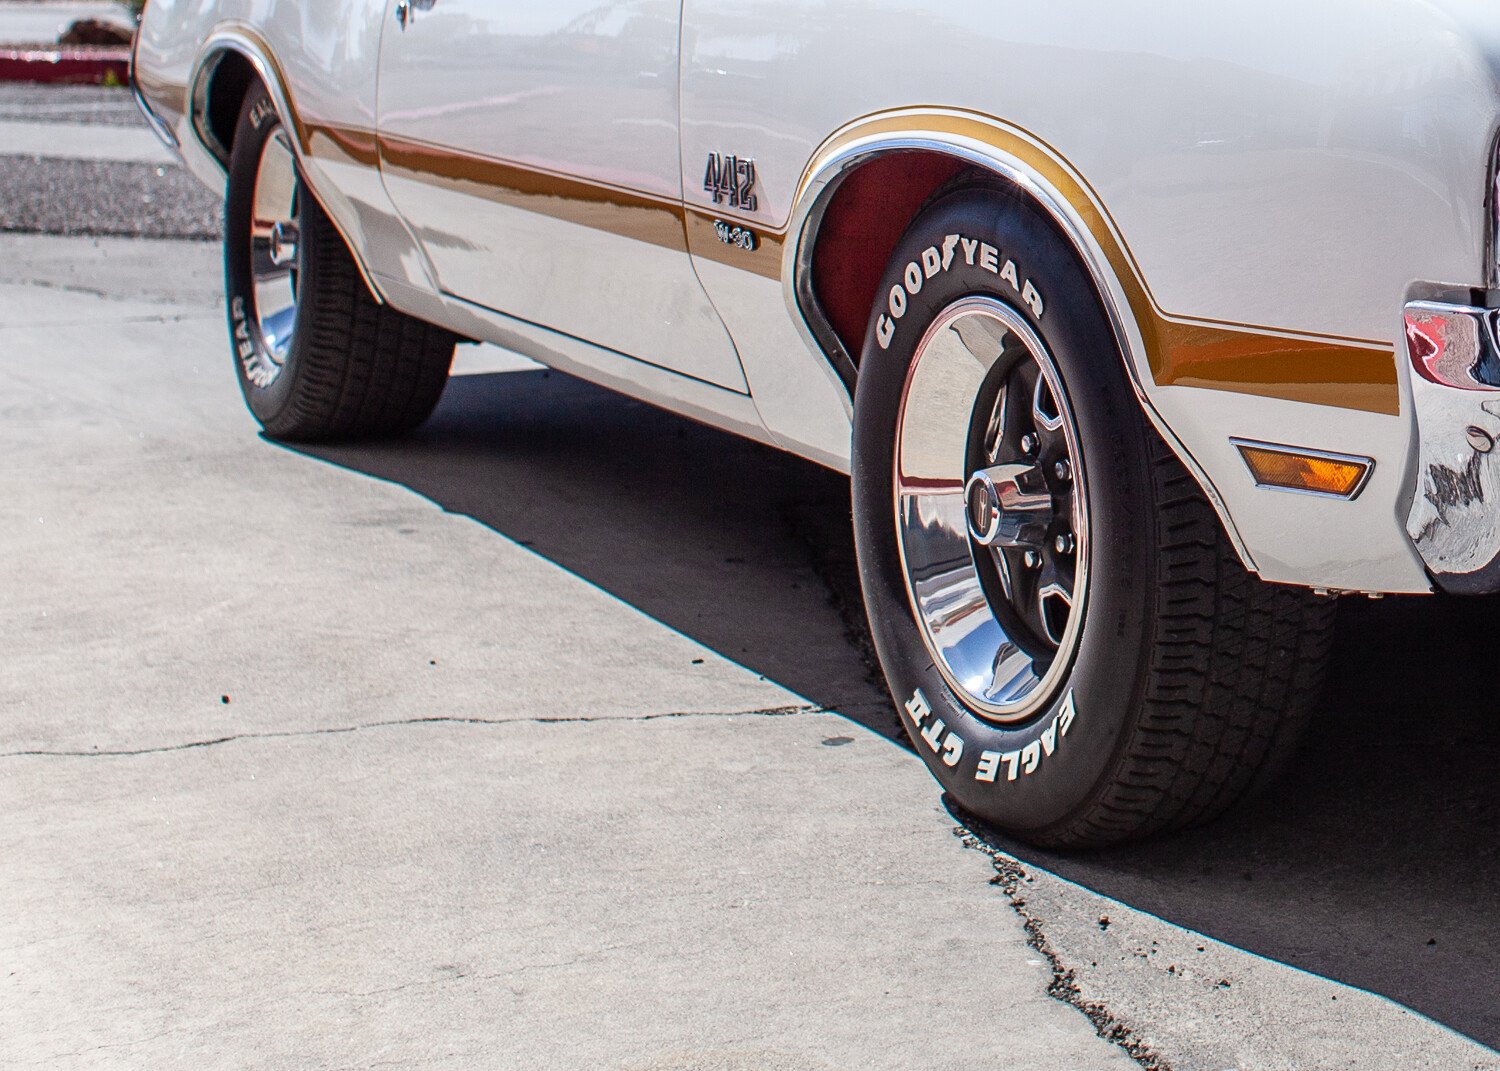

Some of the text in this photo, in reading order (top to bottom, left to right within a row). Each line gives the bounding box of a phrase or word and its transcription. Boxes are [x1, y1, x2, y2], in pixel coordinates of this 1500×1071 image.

[704, 151, 757, 212] 442
[714, 219, 757, 252] W-30
[876, 234, 1044, 349] GOODYEAR
[975, 687, 1076, 782] EAGLE
